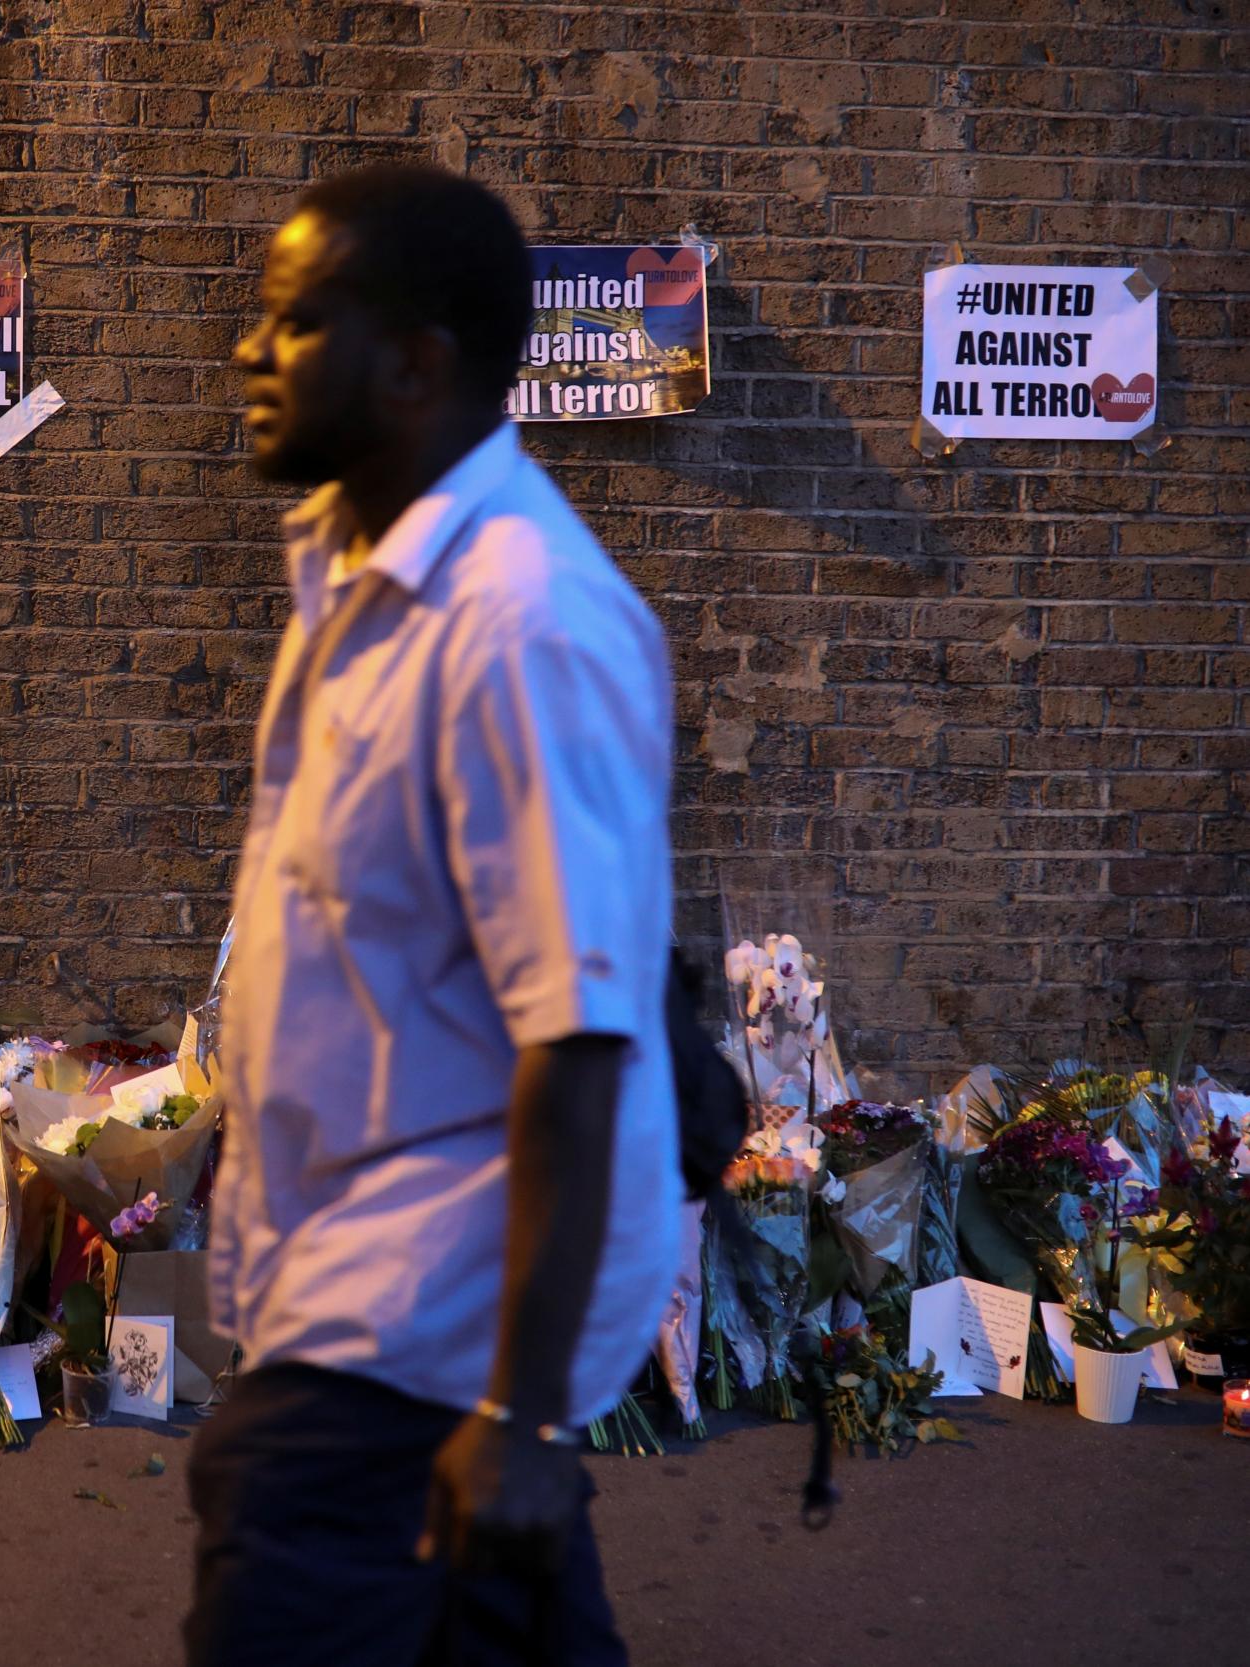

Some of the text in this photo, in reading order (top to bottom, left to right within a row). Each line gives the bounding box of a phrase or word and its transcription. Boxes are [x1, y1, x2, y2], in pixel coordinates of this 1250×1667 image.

[957, 282, 1095, 317] #UNITED
[955, 330, 1093, 367] AGAINST
[550, 380, 656, 414] terror
[932, 381, 1103, 417] ALL TERRO
